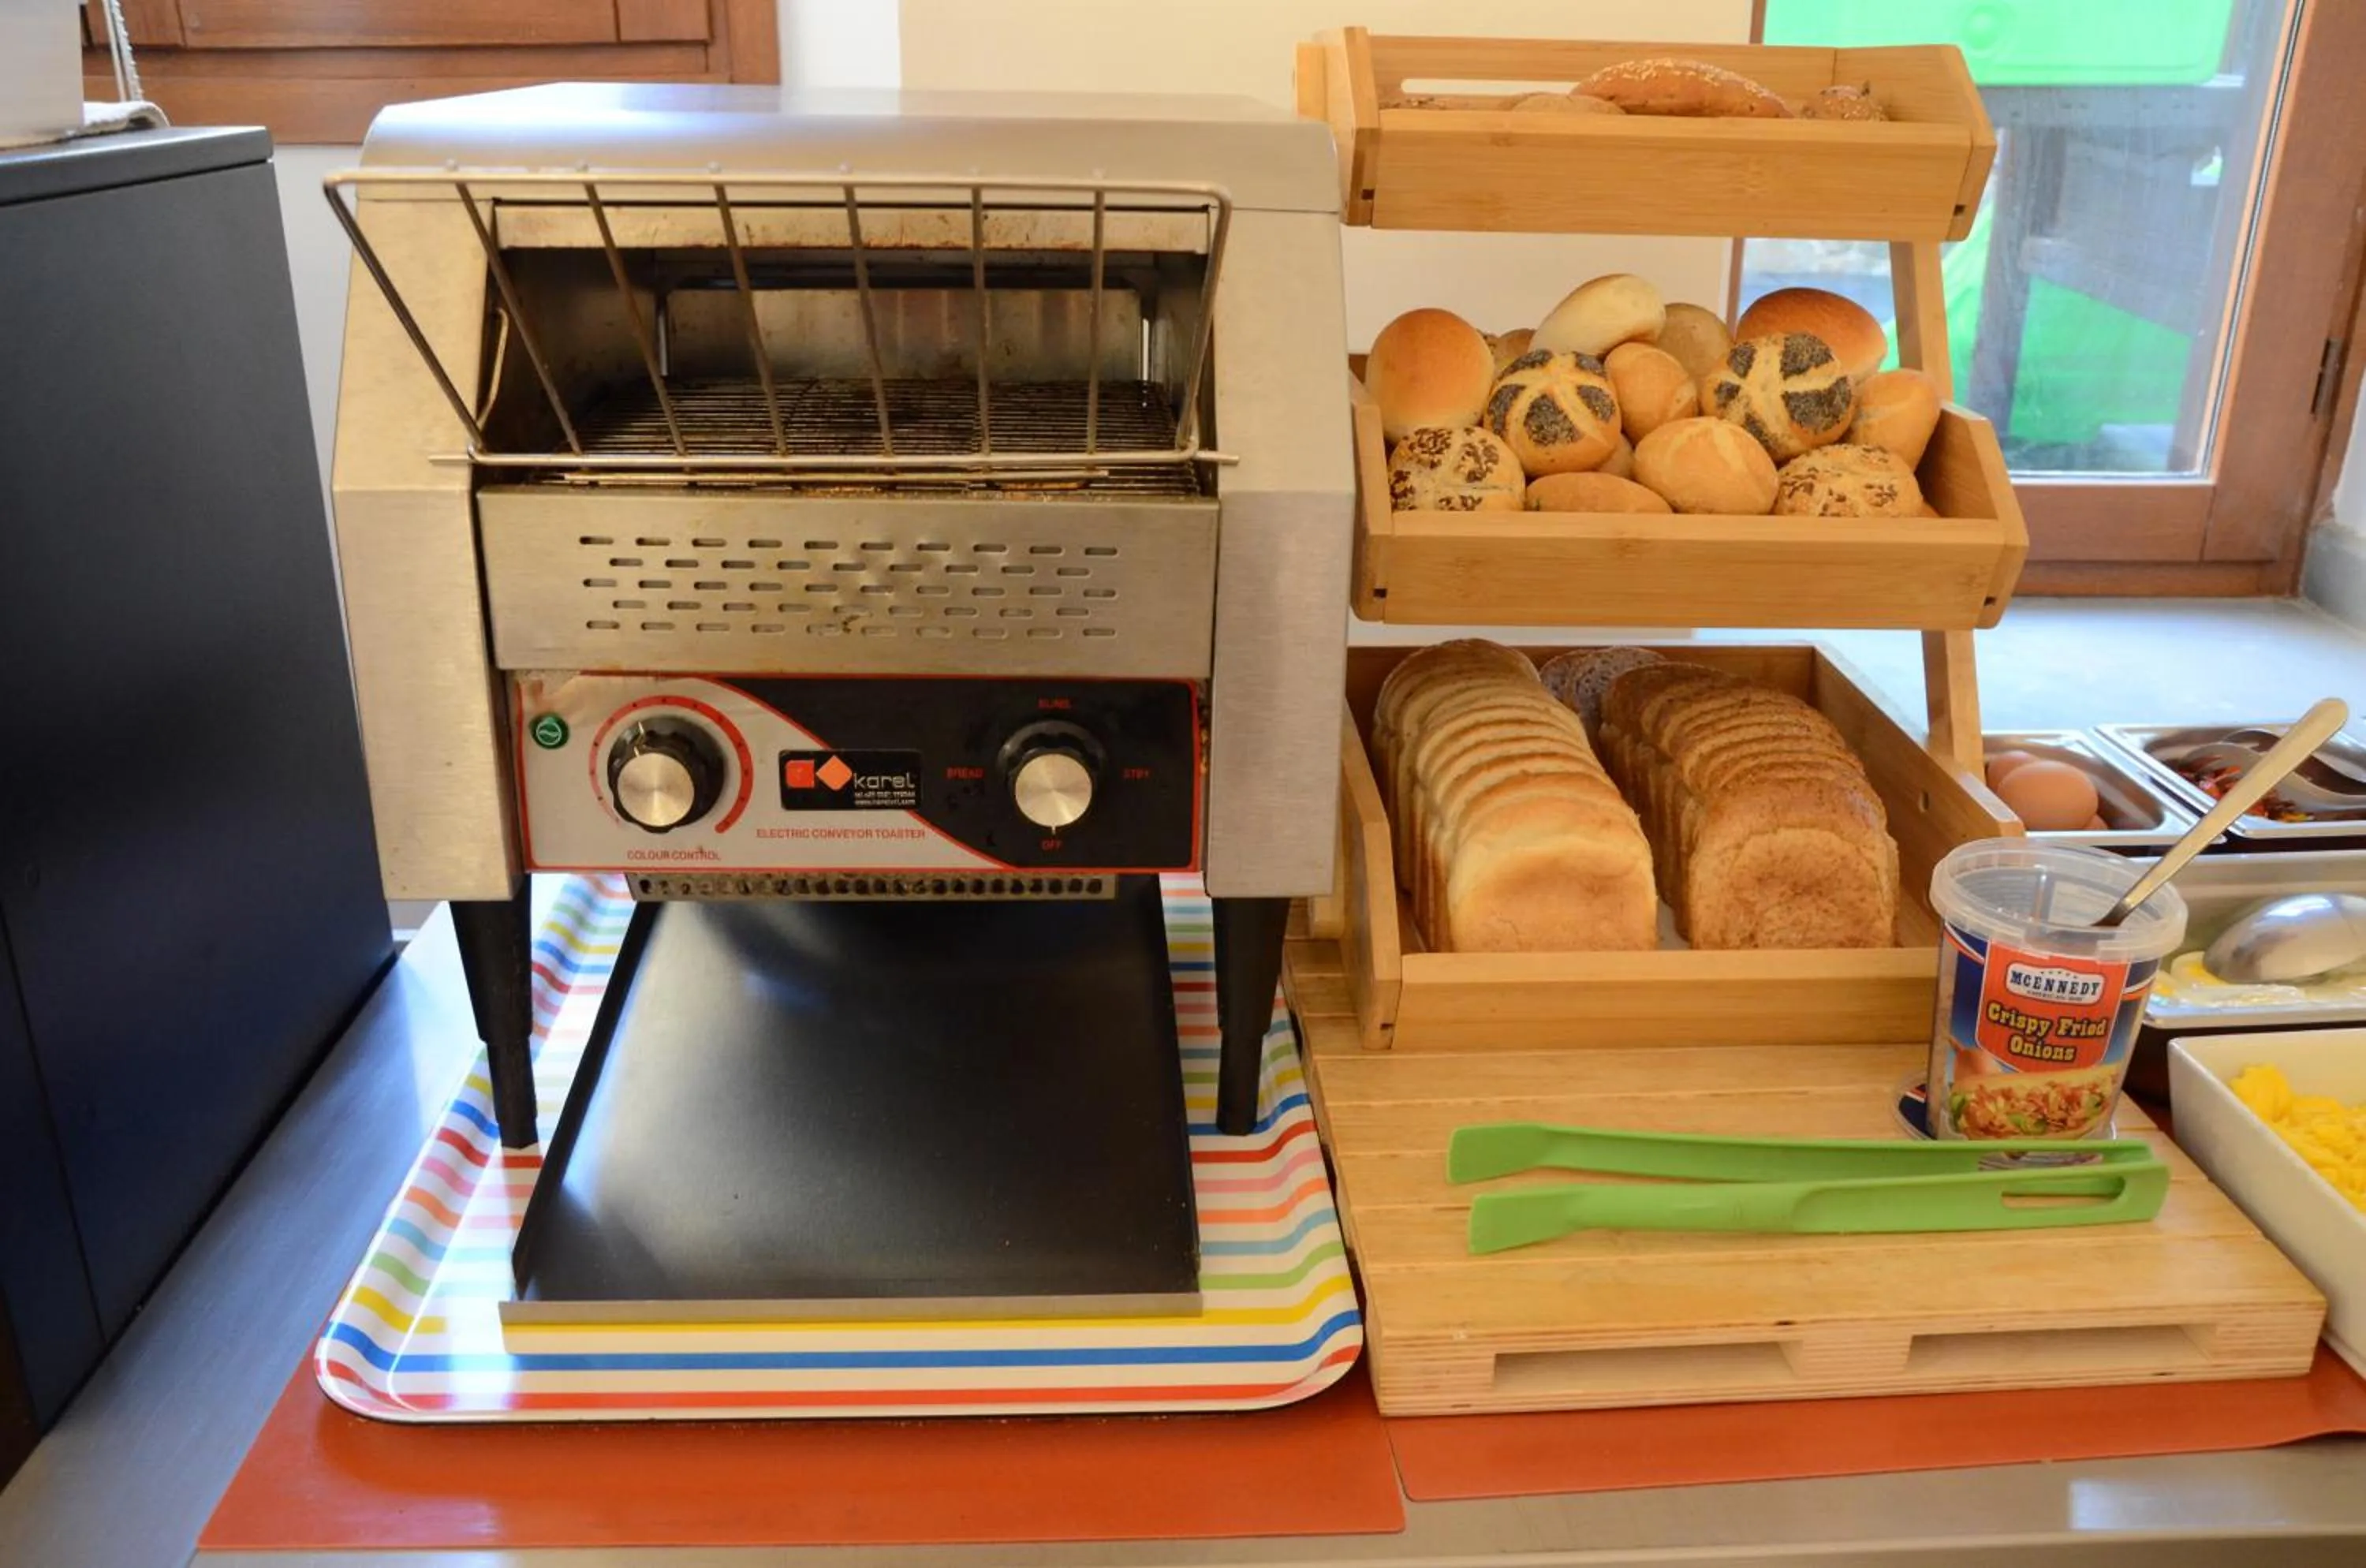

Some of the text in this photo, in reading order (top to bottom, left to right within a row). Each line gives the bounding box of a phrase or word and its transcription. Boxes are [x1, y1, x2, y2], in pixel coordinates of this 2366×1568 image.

[853, 773, 915, 789] karel
[756, 829, 809, 838] ELECTRIC
[627, 850, 670, 860] COLOUR
[2010, 970, 2099, 995] MCENNEDY
[1987, 1002, 2108, 1037] Crispy Fried
[2010, 1034, 2076, 1062] Onions
